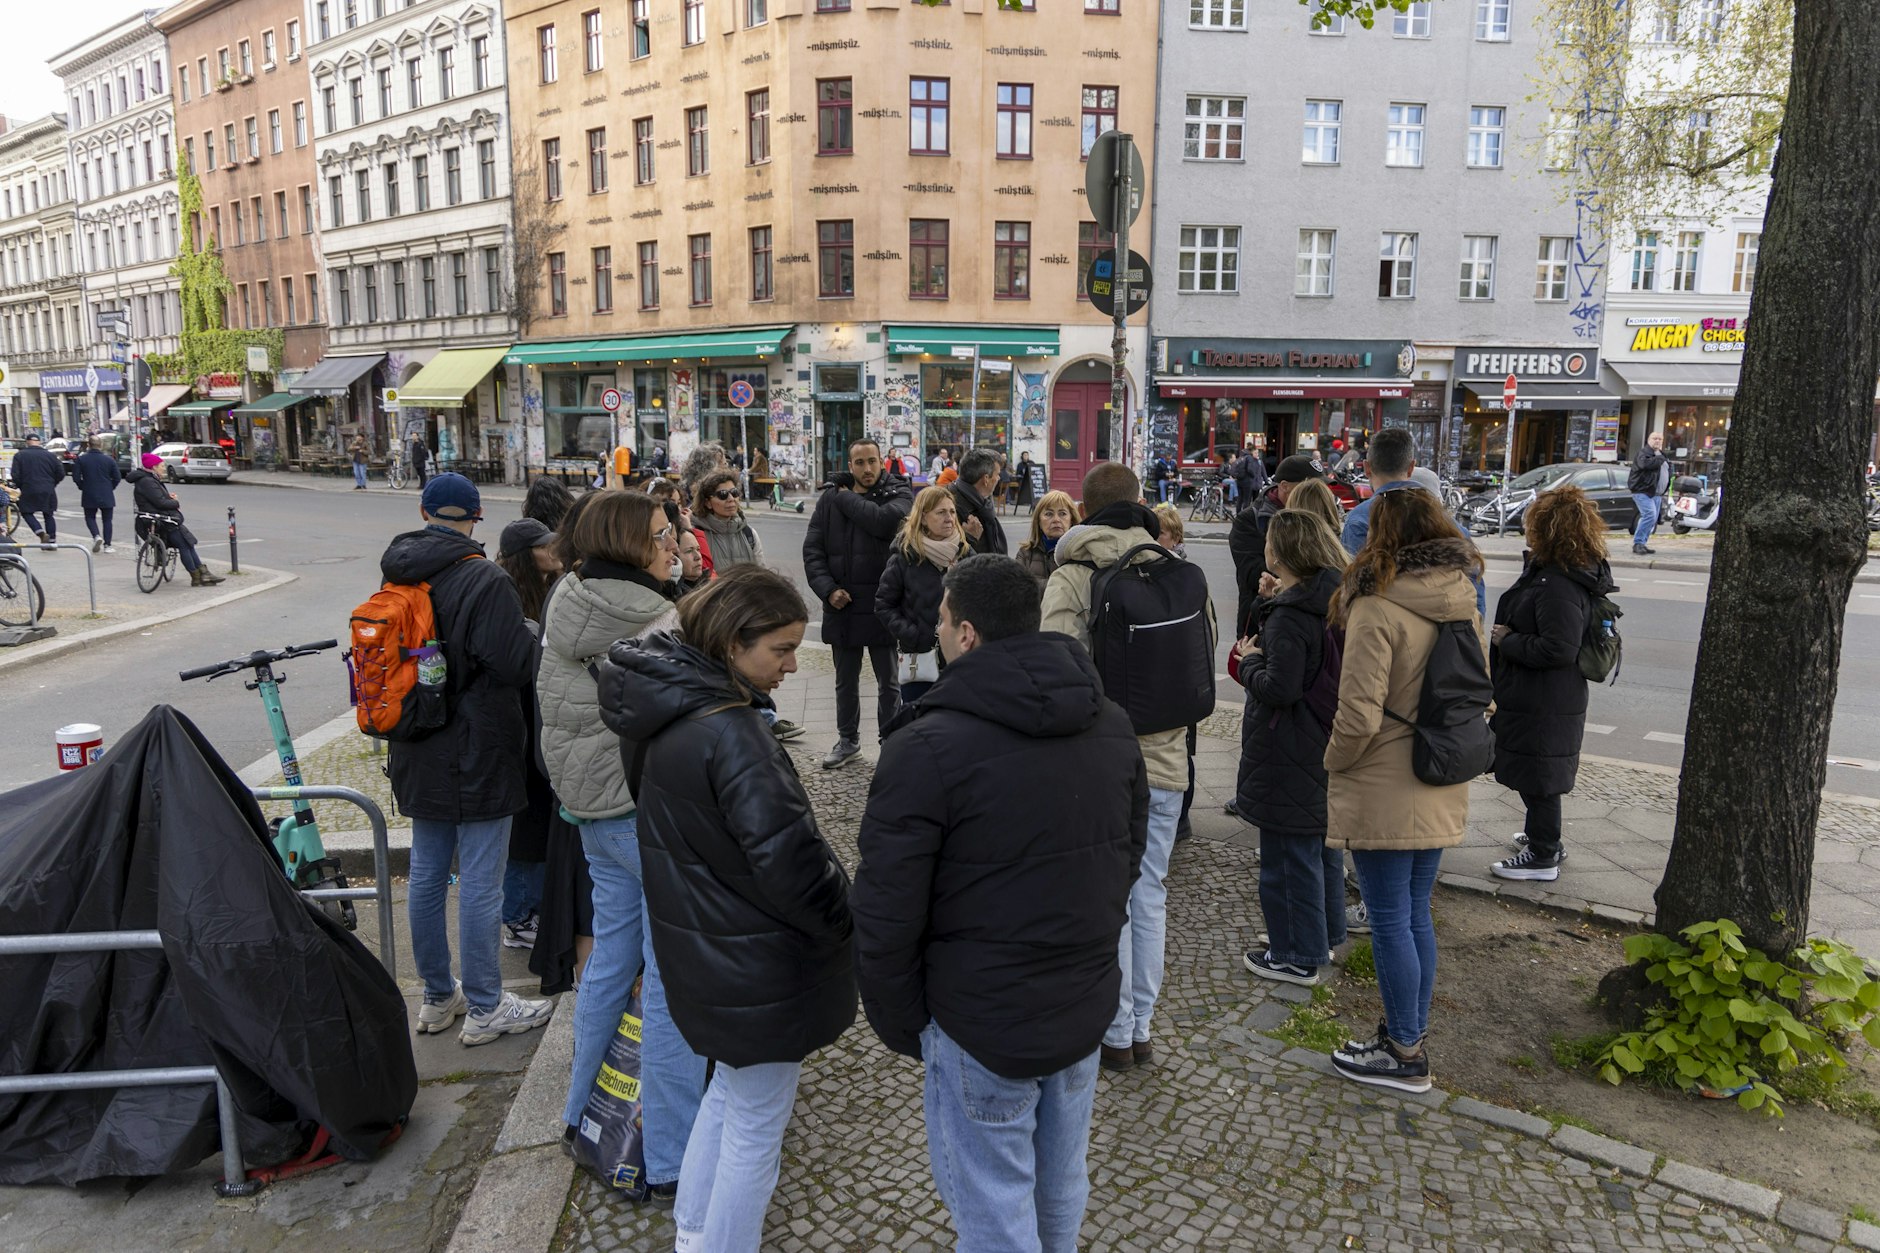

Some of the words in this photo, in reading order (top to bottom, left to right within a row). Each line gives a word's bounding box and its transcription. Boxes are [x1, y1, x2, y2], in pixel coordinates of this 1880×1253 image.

[807, 38, 860, 51] -müşmüşüz.
[1082, 47, 1121, 60] -mişmiş.
[809, 182, 859, 195] -mişmişsin.
[994, 185, 1034, 196] -müştük.
[862, 250, 902, 261] -müşüm.
[1040, 253, 1069, 265] -mişiz.
[1631, 323, 1699, 352] ANGRY
[1702, 329, 1745, 342] CHICK
[1705, 343, 1718, 351] SO
[1720, 343, 1732, 351] SO
[1202, 349, 1284, 368] TAQUERIA
[1288, 349, 1360, 368] FLORIAN
[1466, 353, 1562, 375] PFEIFFERS
[42, 374, 83, 388] ZENTRALRAD
[605, 394, 617, 405] 30
[597, 1066, 639, 1099] ezeichnet!
